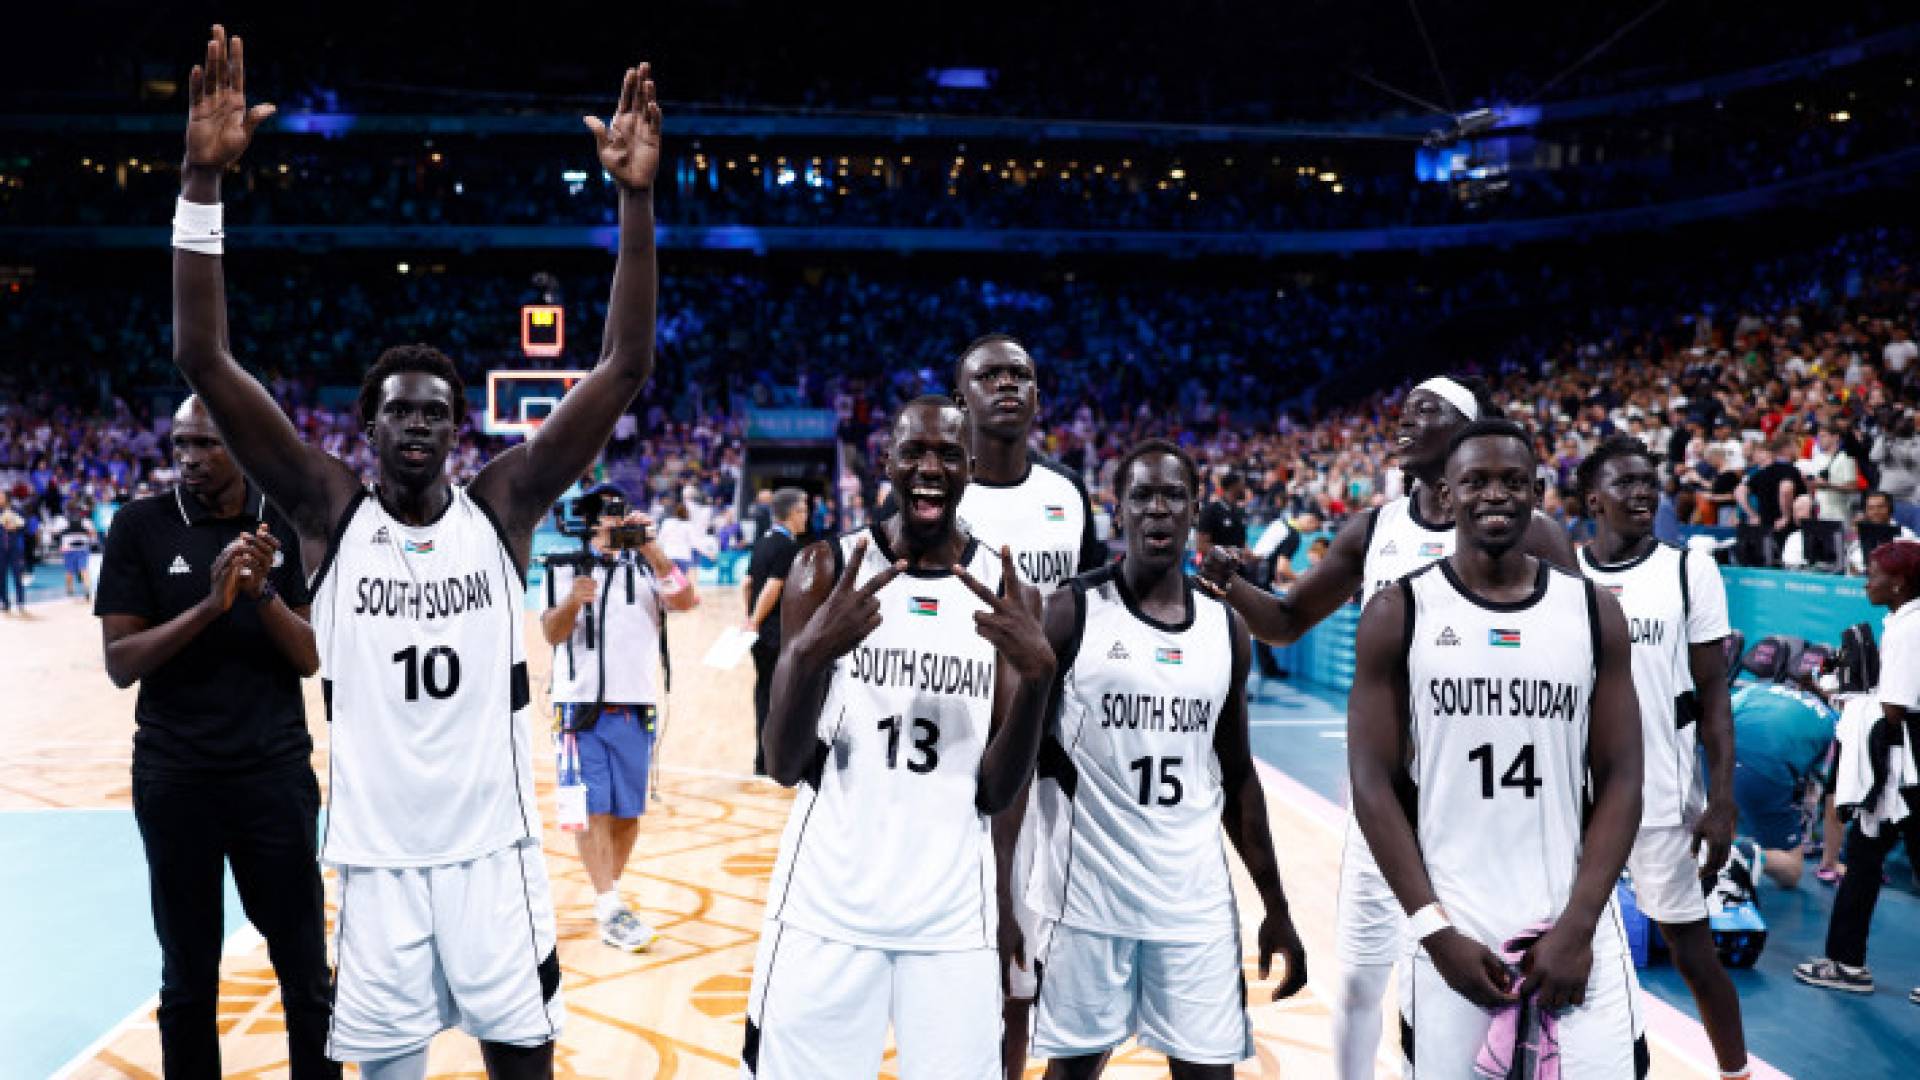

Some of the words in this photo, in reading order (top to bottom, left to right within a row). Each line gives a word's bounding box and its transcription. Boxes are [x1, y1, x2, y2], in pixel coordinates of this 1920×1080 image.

[355, 577, 422, 621] SOUTH
[424, 570, 493, 620] SUDAN
[392, 645, 461, 702] 10
[850, 645, 916, 687] SOUTH
[919, 652, 993, 700] SUDAN
[1101, 692, 1165, 730] SOUTH
[1430, 677, 1503, 717] SOUTH
[1508, 677, 1579, 722] SUDAN
[877, 715, 940, 774] 13
[1468, 741, 1543, 800] 14
[1129, 755, 1184, 807] 15
